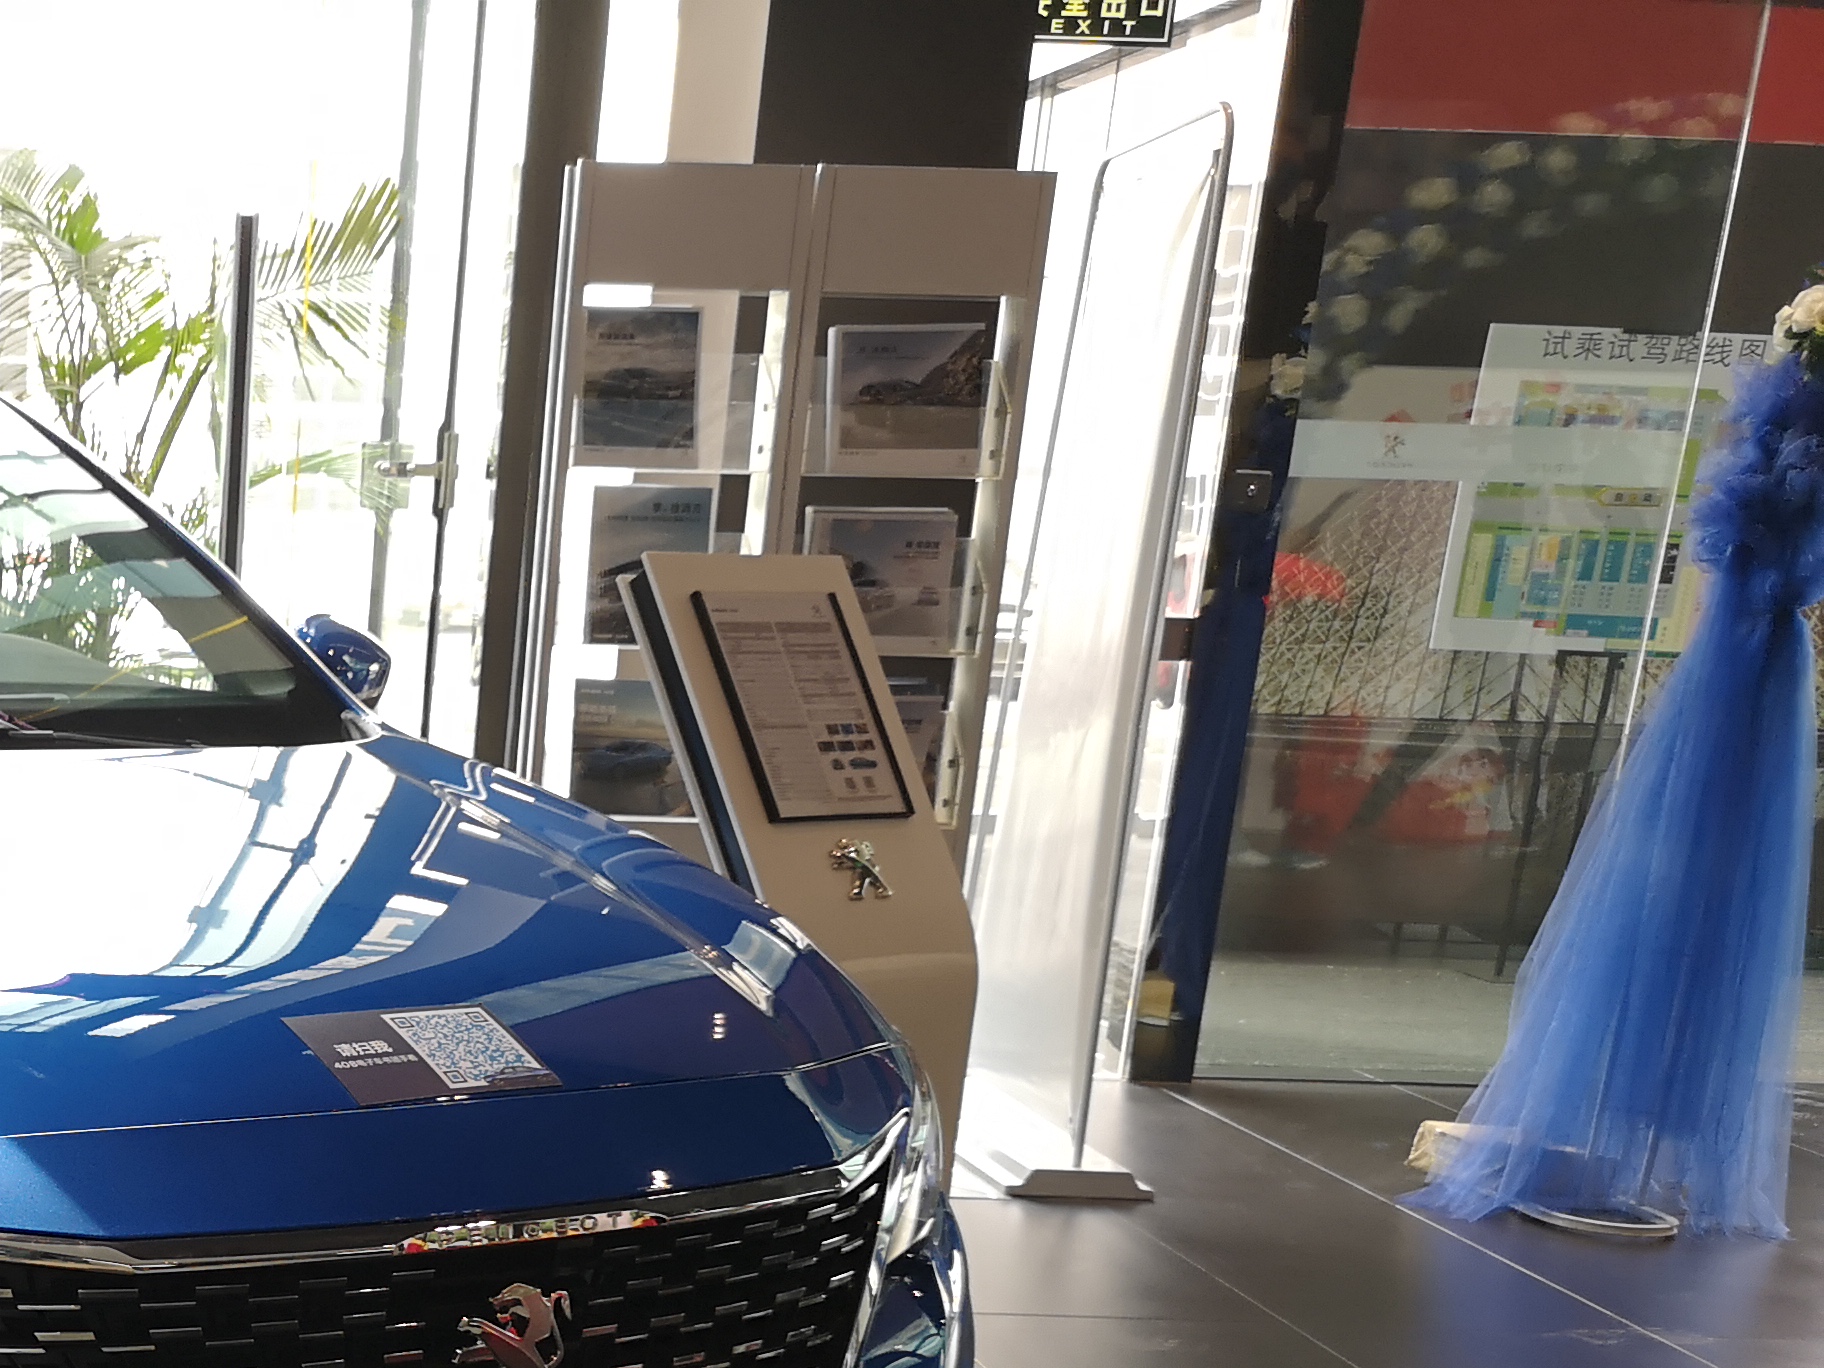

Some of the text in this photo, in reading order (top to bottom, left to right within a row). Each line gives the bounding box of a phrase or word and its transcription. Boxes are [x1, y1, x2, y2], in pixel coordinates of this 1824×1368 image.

[1050, 19, 1136, 35] EXIT
[1542, 330, 1768, 368] 试乘试驾路线图
[333, 1040, 394, 1057] 请扫我
